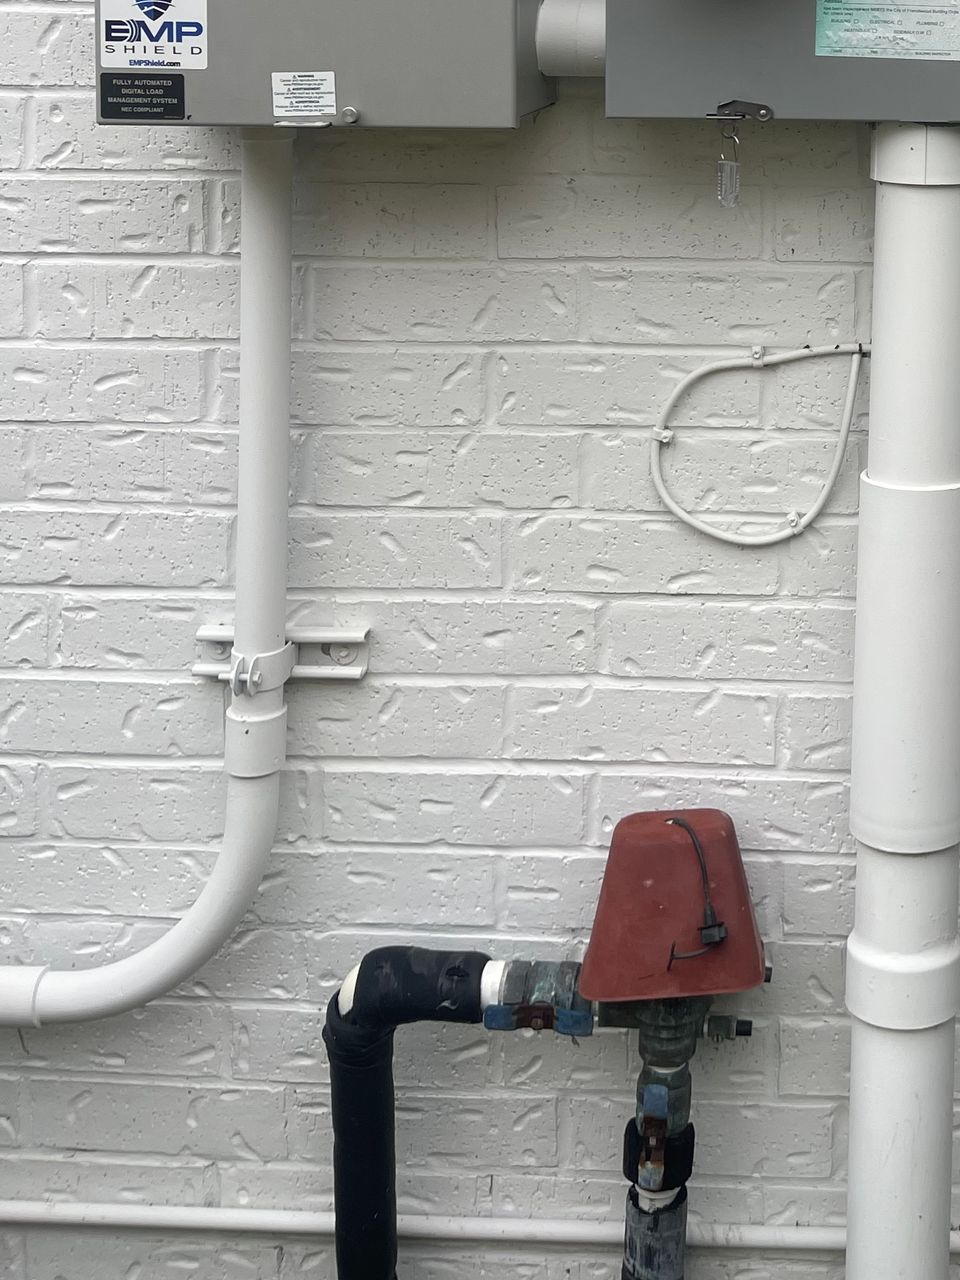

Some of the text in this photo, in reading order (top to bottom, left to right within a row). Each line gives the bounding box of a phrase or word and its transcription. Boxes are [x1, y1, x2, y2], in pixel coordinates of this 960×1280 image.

[104, 19, 204, 43] EMP
[105, 44, 203, 55] SHIELD
[128, 59, 181, 67] EMPShield.com
